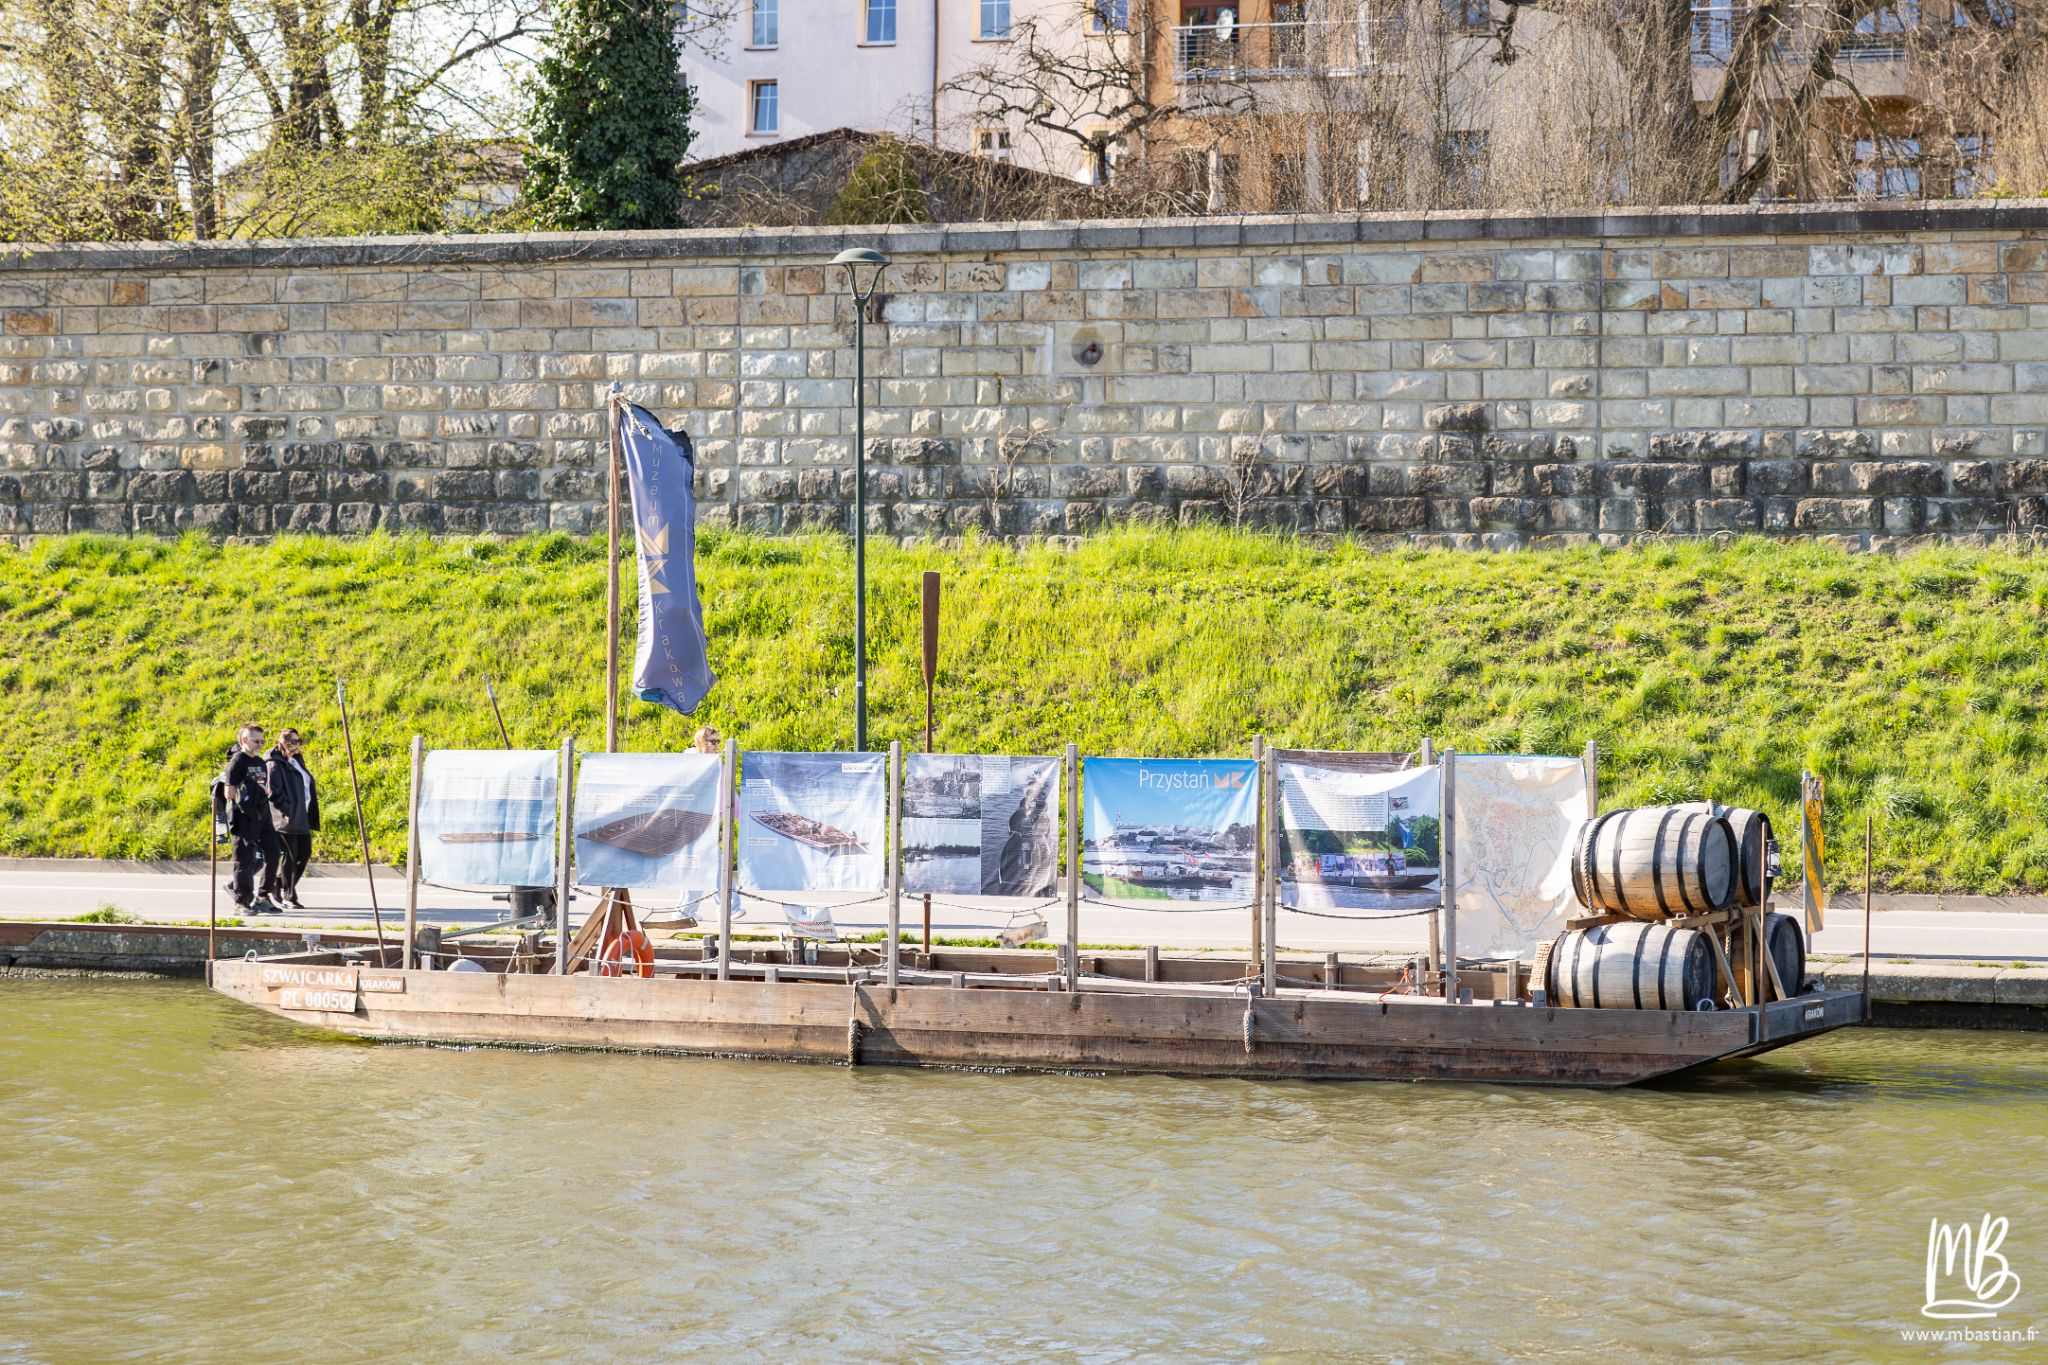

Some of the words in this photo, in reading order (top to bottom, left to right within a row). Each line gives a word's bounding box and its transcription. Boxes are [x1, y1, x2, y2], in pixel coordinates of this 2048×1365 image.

[654, 599, 686, 703] Krakowa
[1138, 768, 1209, 792] Przystań
[262, 969, 354, 987] SZWAJCARKA
[360, 977, 402, 990] KRAKÓW
[283, 990, 302, 1007] PL
[1804, 1005, 1825, 1020] KRAKÓW
